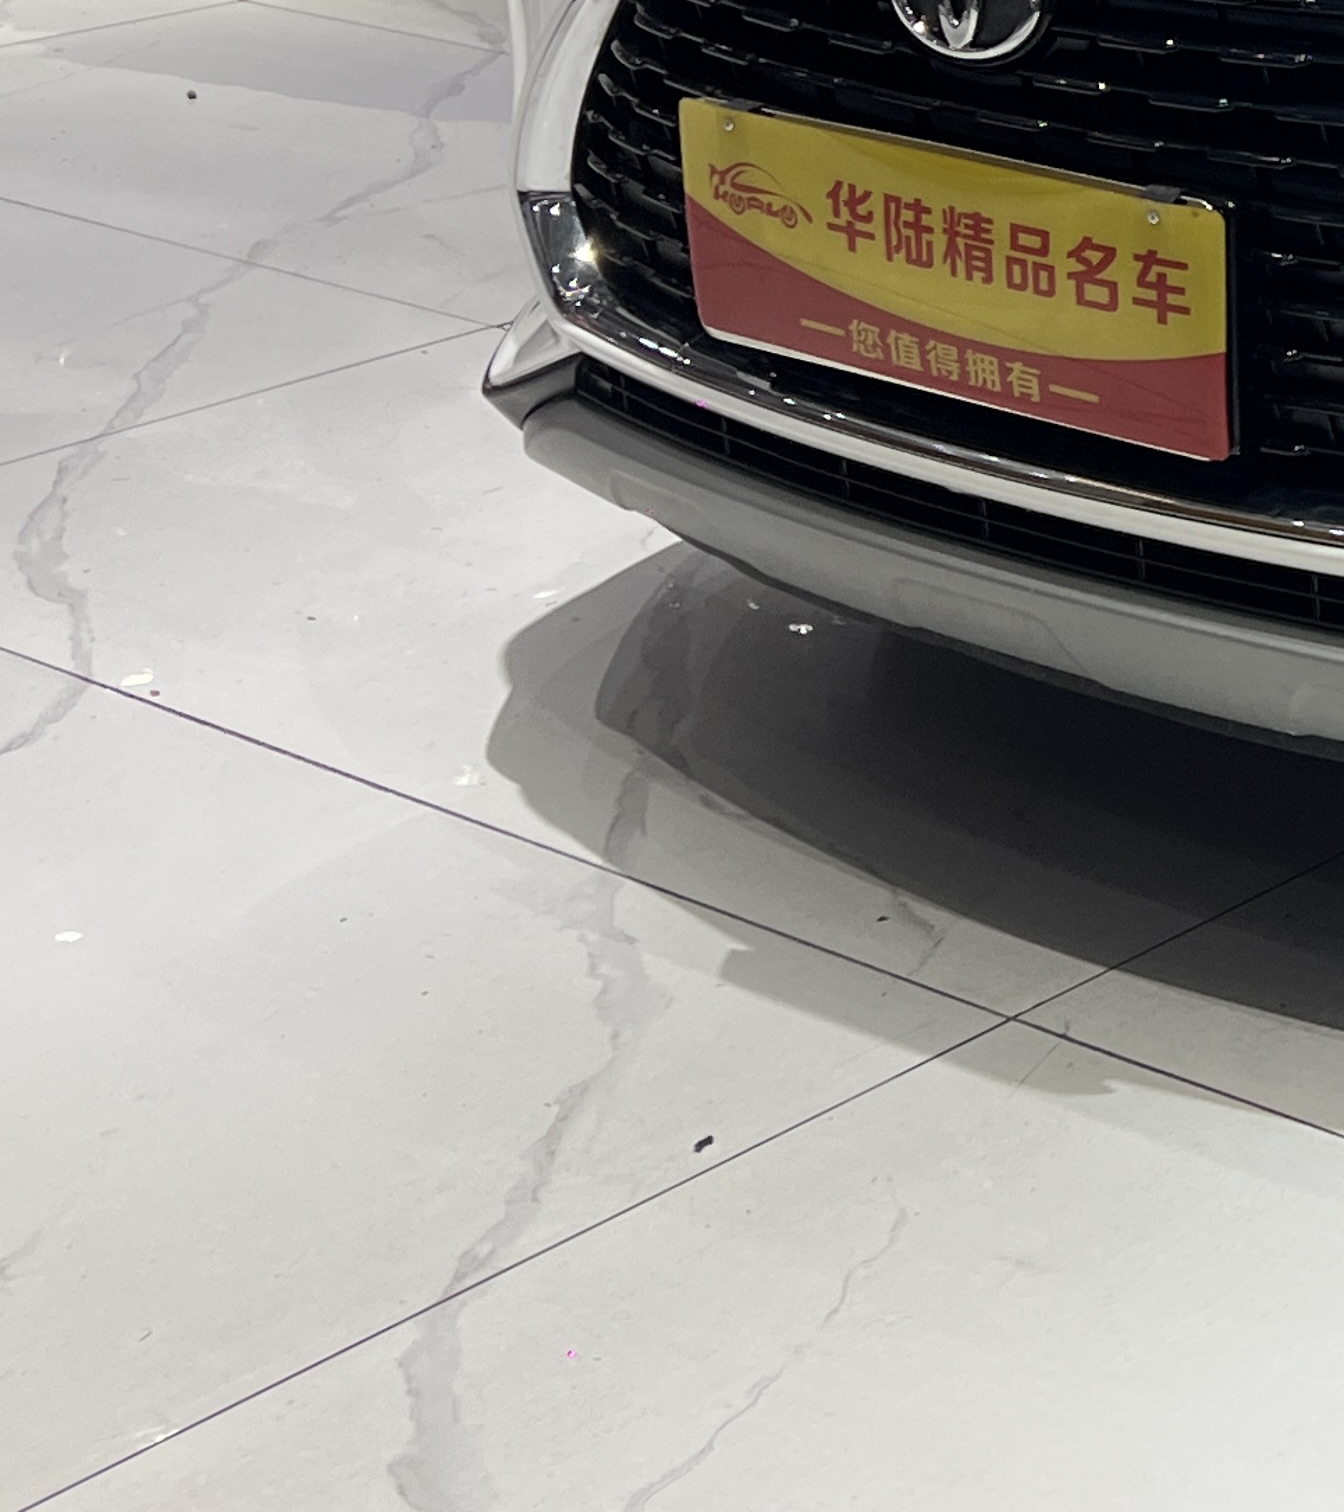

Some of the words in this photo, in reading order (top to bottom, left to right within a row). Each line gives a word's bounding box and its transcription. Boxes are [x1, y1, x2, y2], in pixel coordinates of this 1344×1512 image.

[826, 180, 1192, 326] 华陆精品名车
